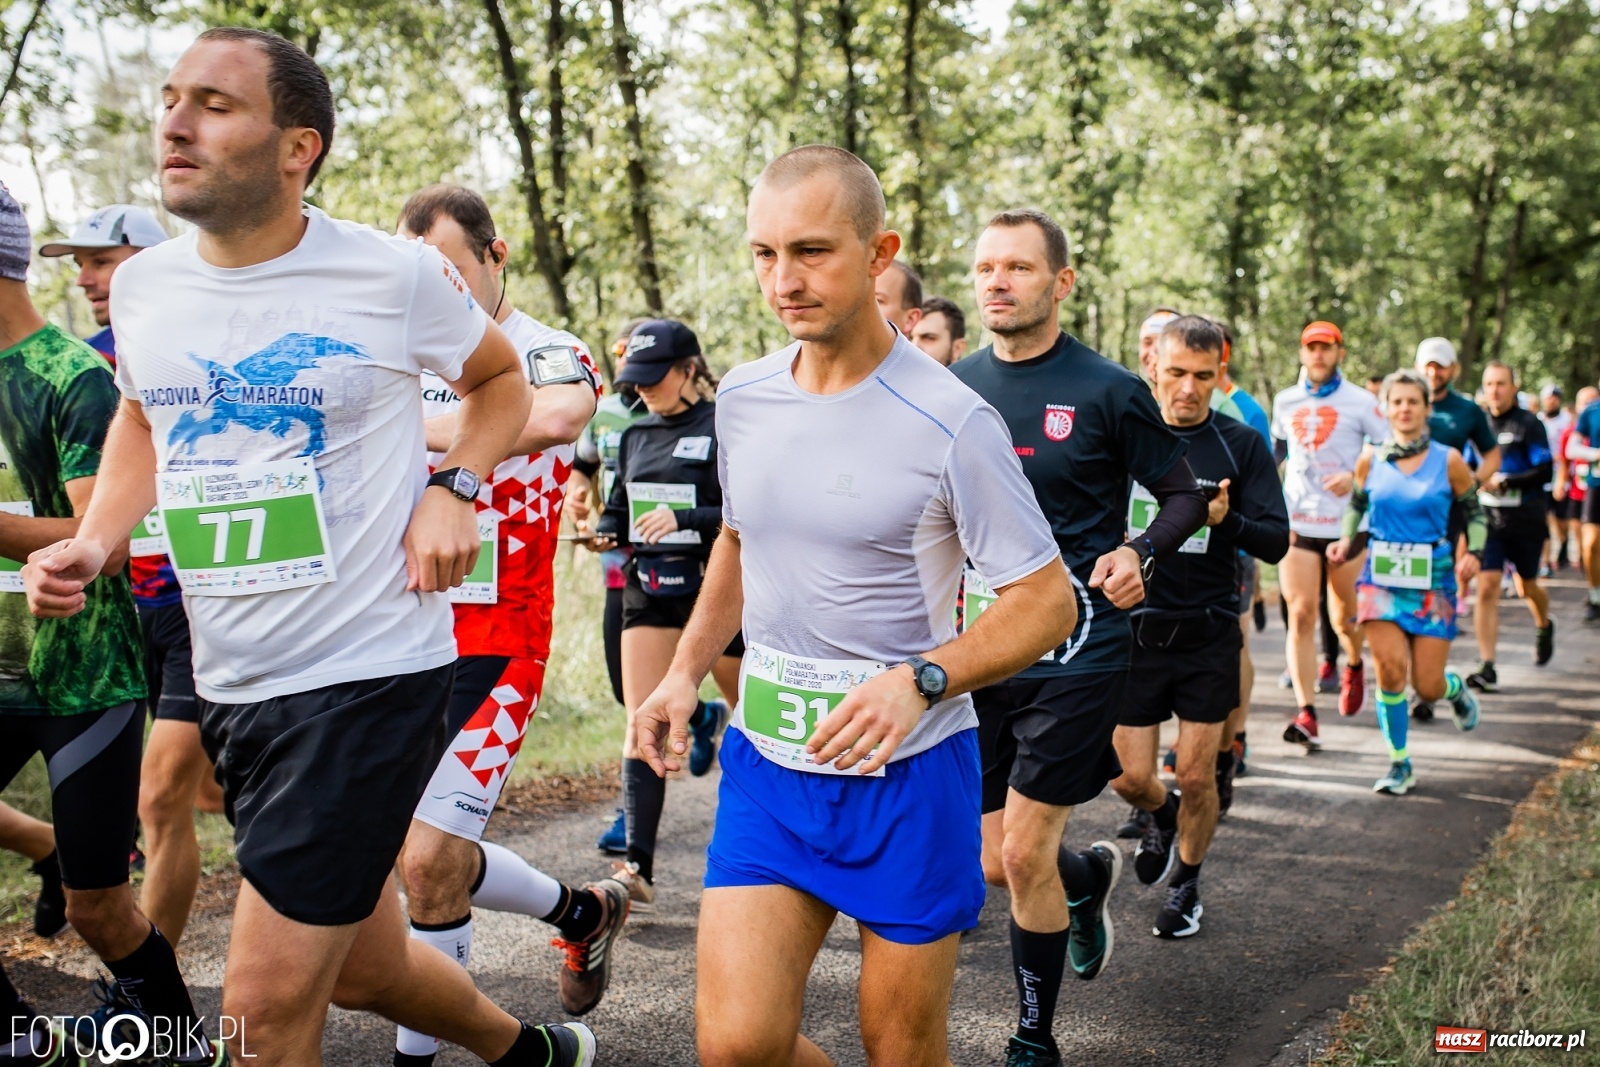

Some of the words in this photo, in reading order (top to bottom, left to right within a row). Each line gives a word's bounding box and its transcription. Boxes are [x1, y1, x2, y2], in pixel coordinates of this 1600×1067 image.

[242, 387, 323, 405] MARATON
[198, 507, 267, 563] 77
[1389, 557, 1412, 576] 21
[658, 576, 685, 585] PLEASE
[777, 655, 785, 682] V
[807, 680, 822, 689] 2020
[777, 692, 829, 740] 31
[1019, 966, 1041, 1029] Kalenji
